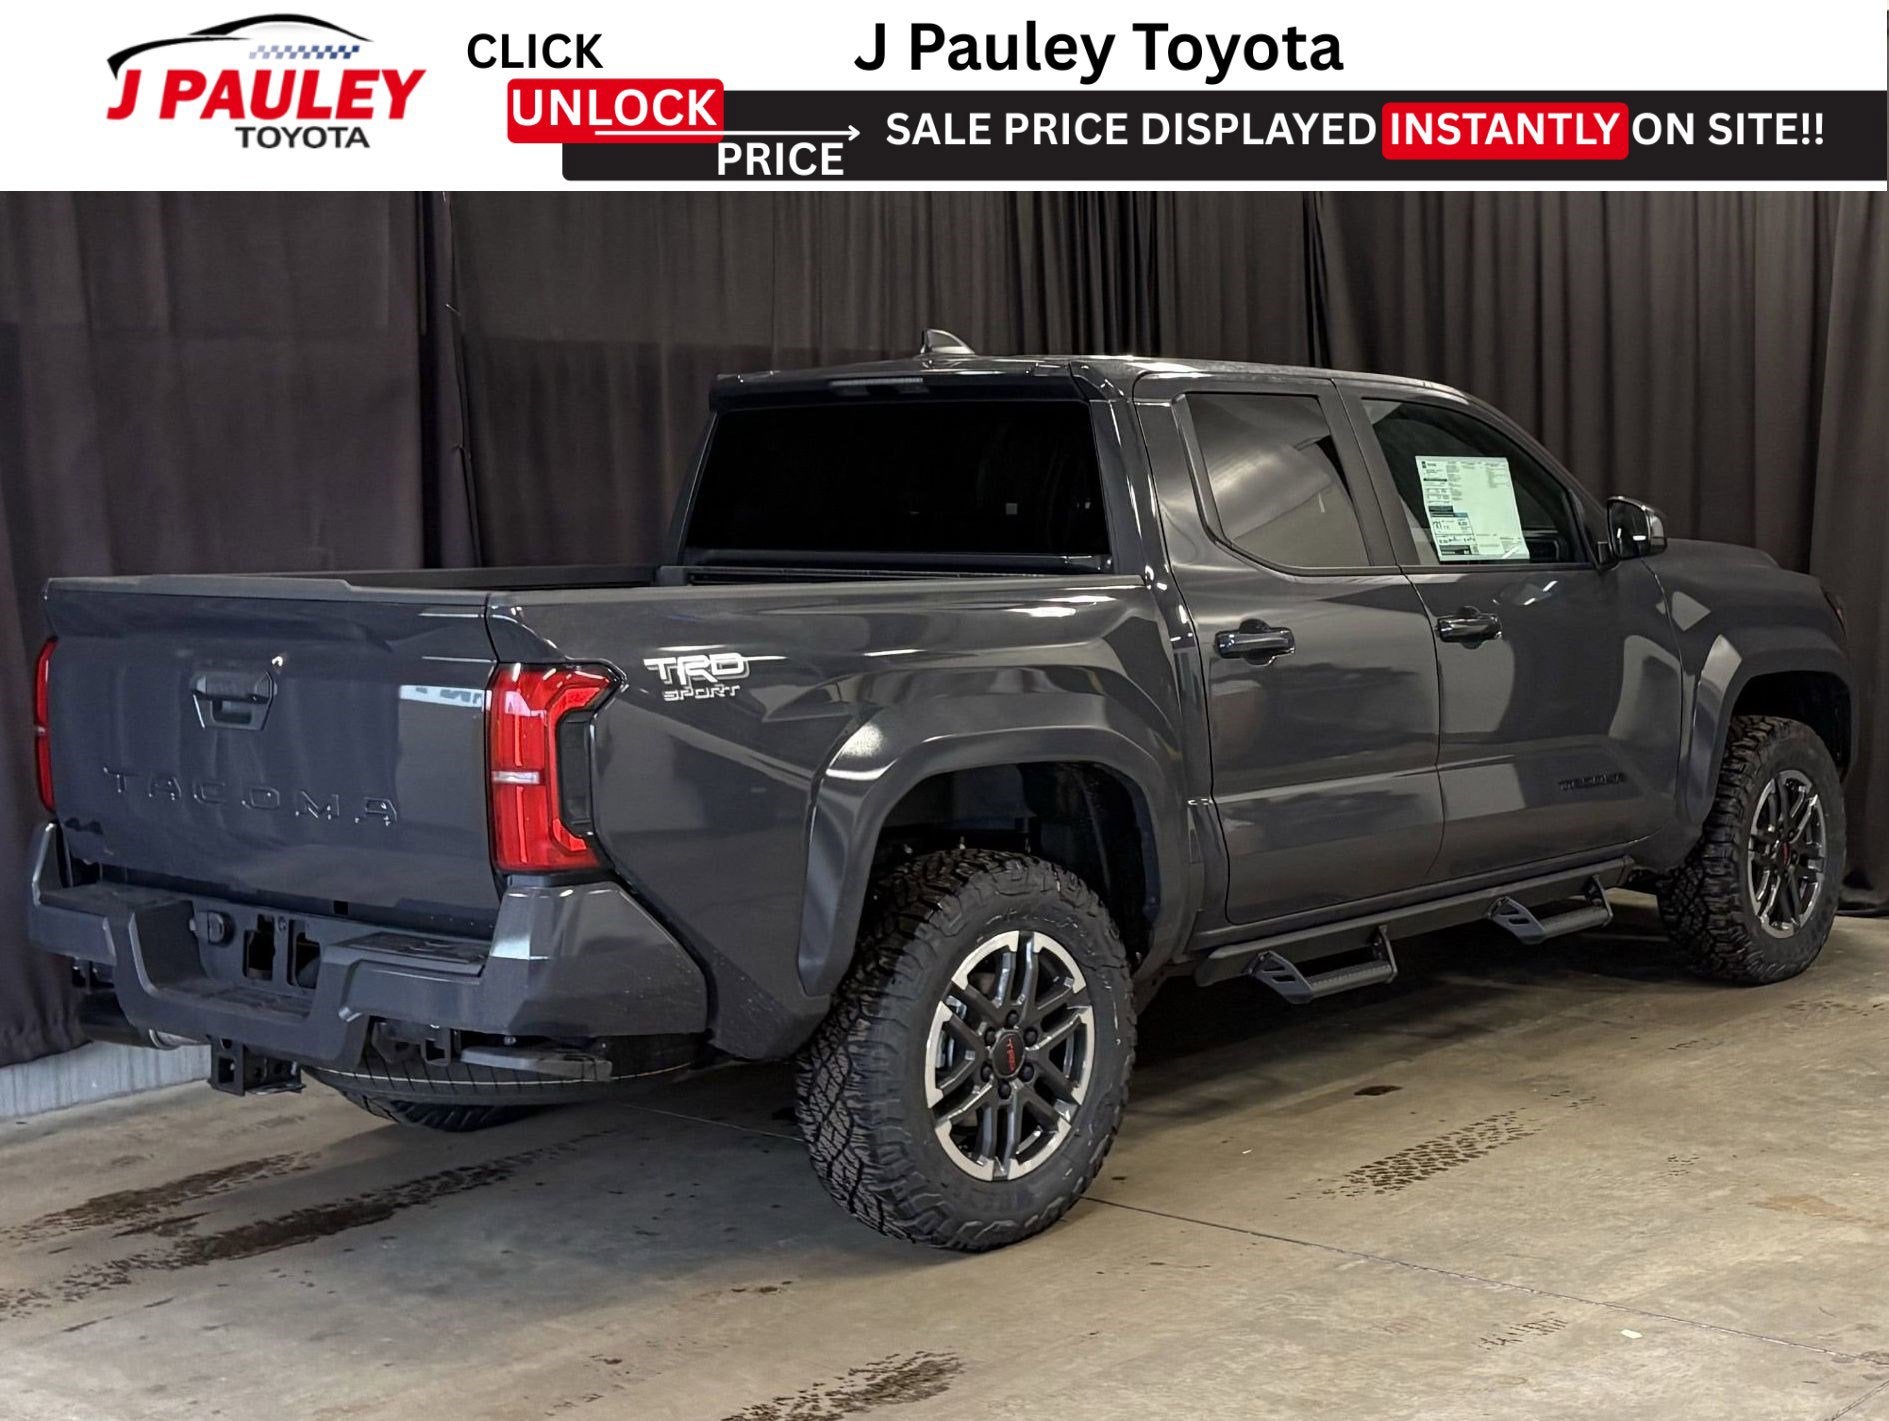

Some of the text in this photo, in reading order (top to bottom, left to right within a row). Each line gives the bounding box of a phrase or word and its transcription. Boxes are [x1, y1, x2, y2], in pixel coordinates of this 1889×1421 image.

[643, 652, 751, 689] TRD
[664, 685, 742, 702] SPORT
[102, 765, 398, 826] TACOMA
